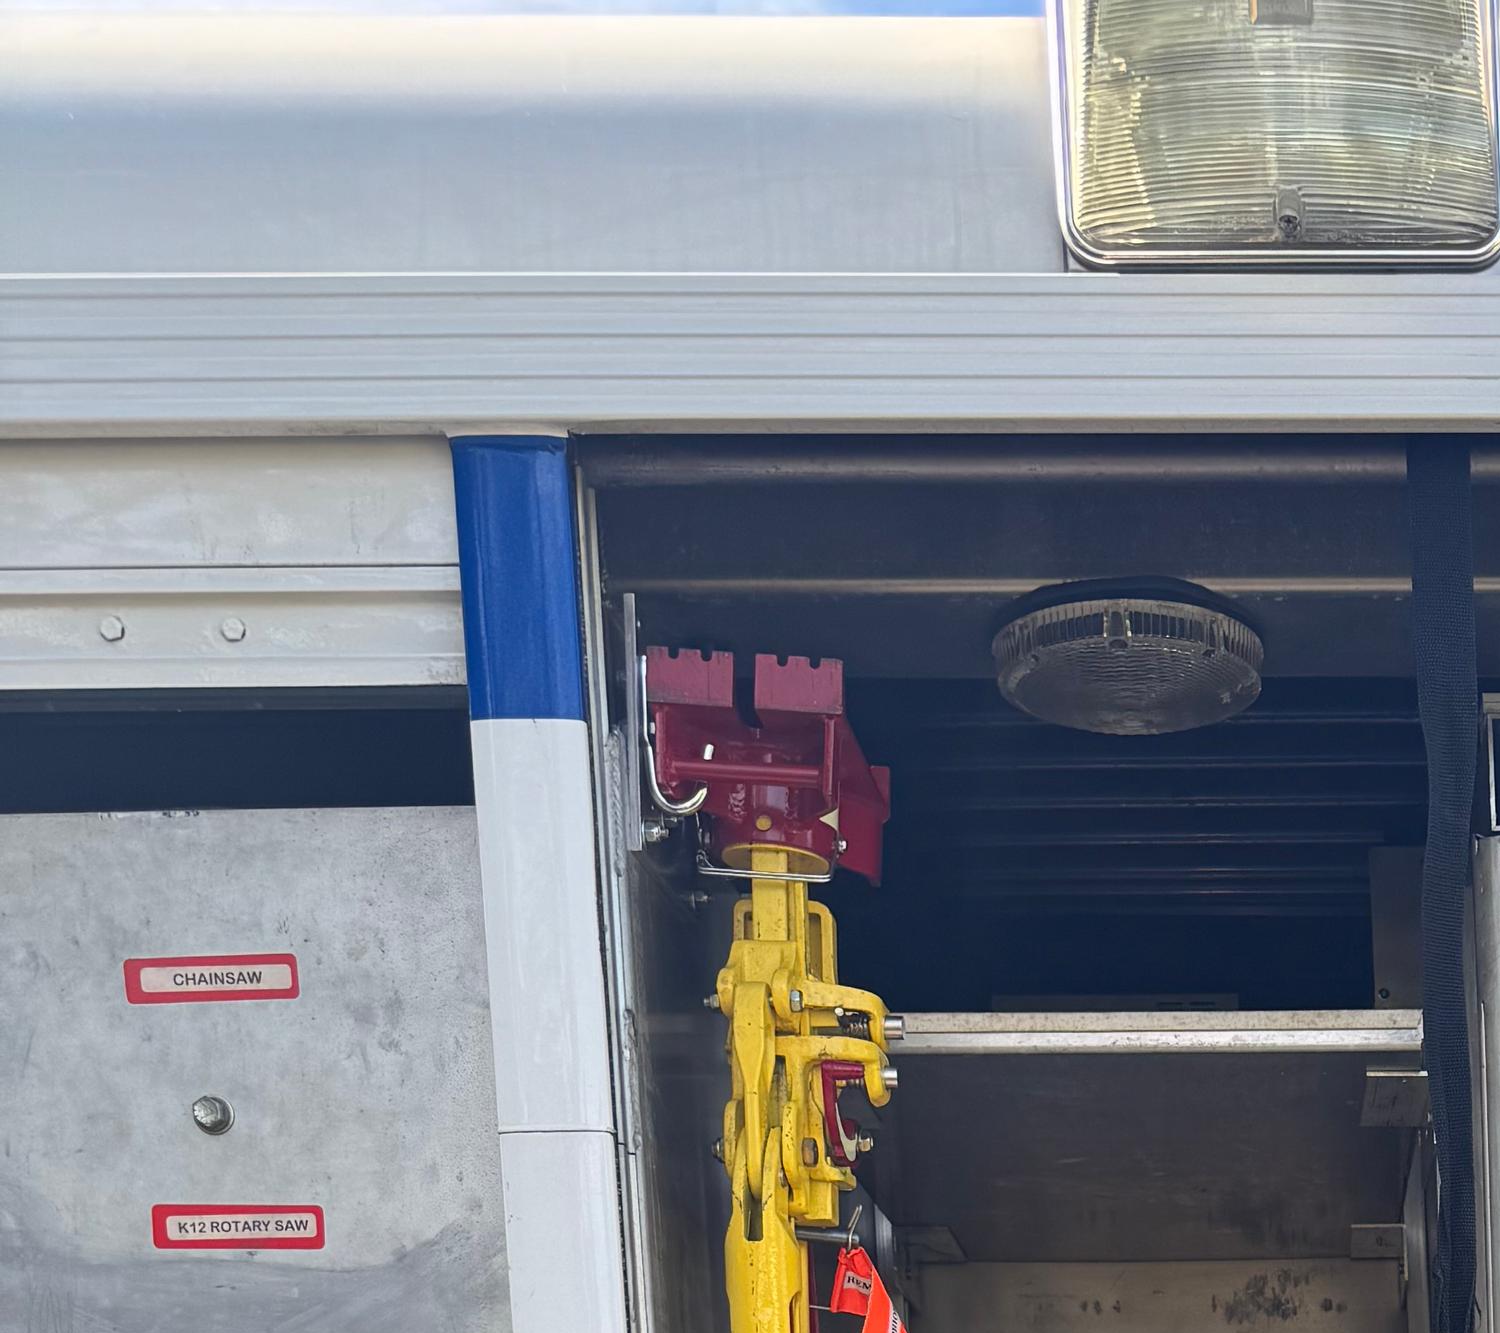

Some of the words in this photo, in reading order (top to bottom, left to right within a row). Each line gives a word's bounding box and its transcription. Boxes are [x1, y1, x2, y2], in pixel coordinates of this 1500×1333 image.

[173, 971, 262, 986] CHAINSAW
[178, 1221, 207, 1234] K12
[210, 1220, 271, 1233] ROTARY
[275, 1219, 309, 1232] SAW
[847, 1275, 872, 1291] REM
